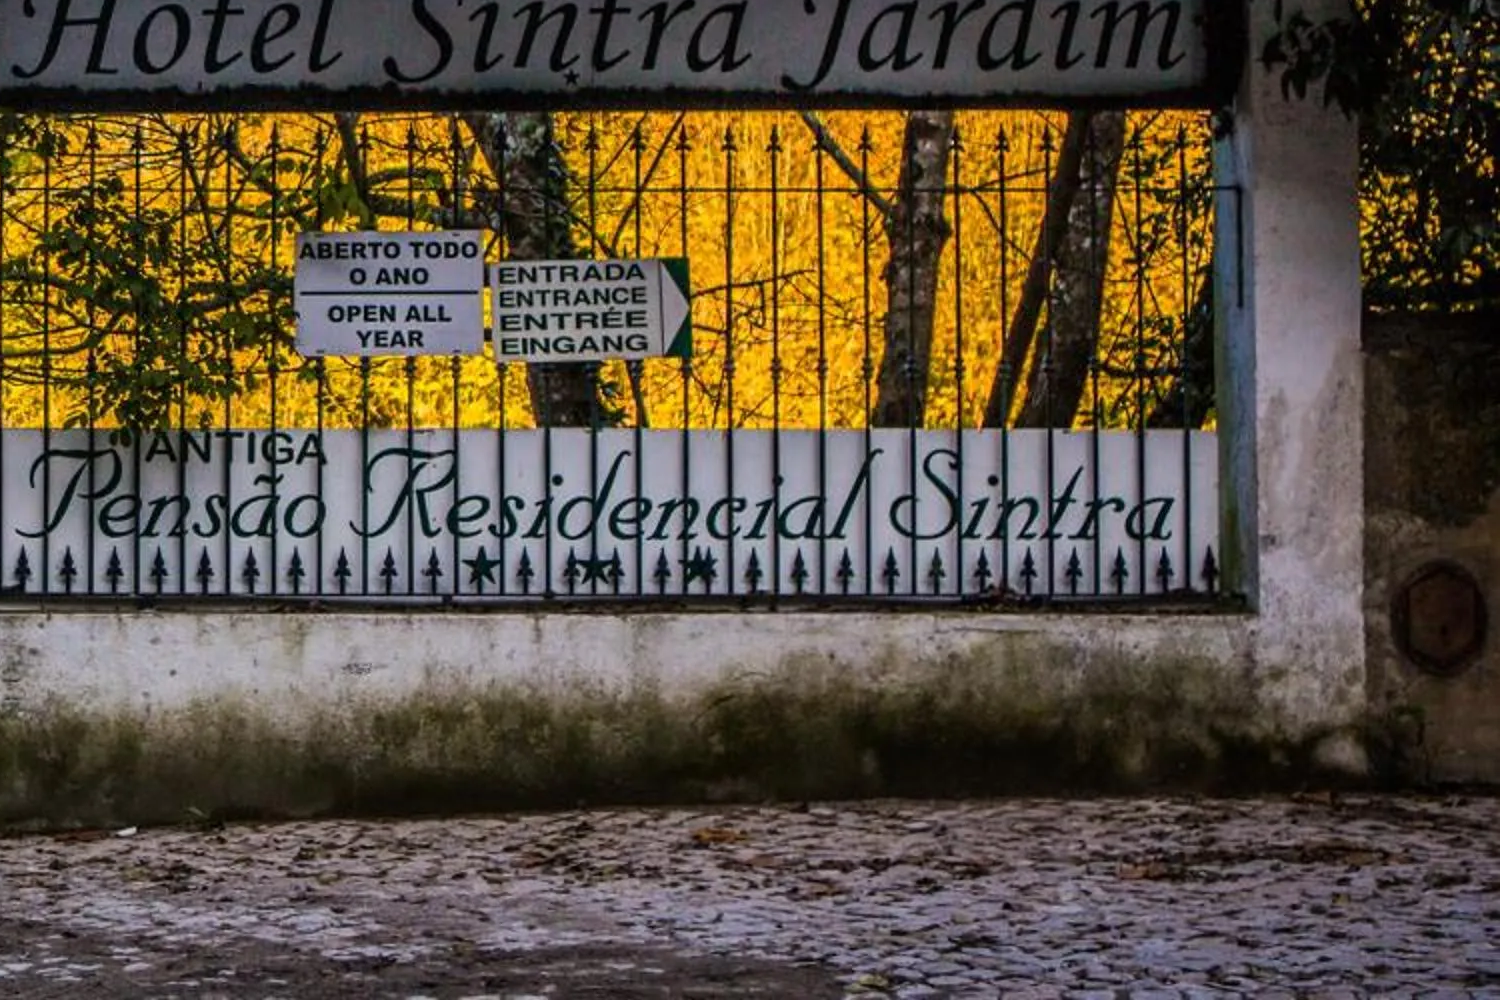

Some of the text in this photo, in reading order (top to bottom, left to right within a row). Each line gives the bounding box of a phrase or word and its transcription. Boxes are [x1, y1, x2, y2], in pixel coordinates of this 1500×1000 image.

[299, 240, 478, 260] ABERTO TODO
[350, 267, 430, 286] O ANO
[499, 263, 646, 285] ENTRADA
[499, 286, 648, 309] ENTRANCE
[327, 304, 453, 323] OPEN ALL
[500, 306, 649, 332] ENTRÉE
[356, 329, 425, 349] YEAR
[501, 333, 649, 356] EINGANG
[145, 430, 328, 466] ANTIGA
[15, 447, 1176, 541] Pensão Residencial Sintra
